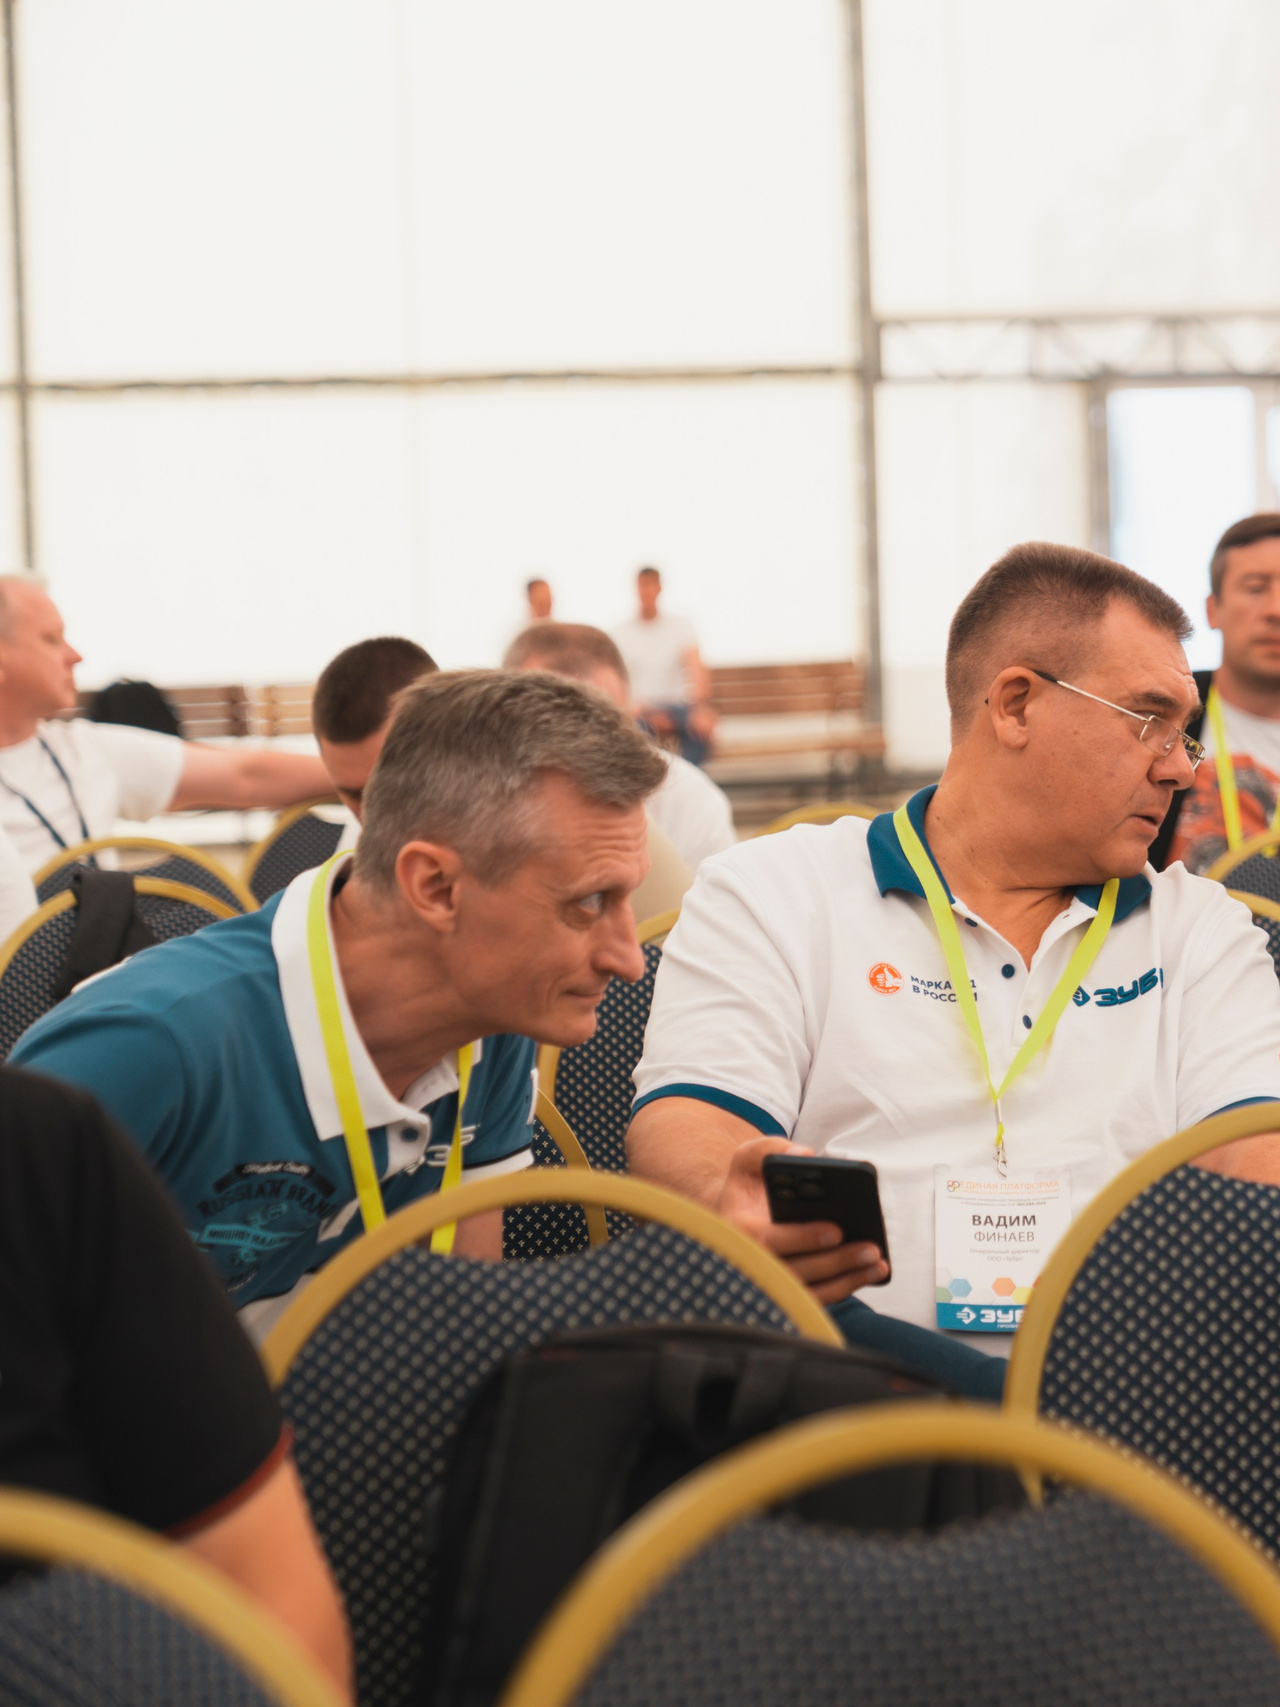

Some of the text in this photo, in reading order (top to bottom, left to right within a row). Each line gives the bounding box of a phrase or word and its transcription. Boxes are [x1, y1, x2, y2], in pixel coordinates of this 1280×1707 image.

[910, 975, 952, 990] МАРКА
[912, 985, 978, 1003] В РОСС
[972, 1214, 1037, 1229] ВАДИМ
[974, 1231, 1035, 1242] ФИНАЕВ
[980, 1309, 1024, 1324] ЗУБ
